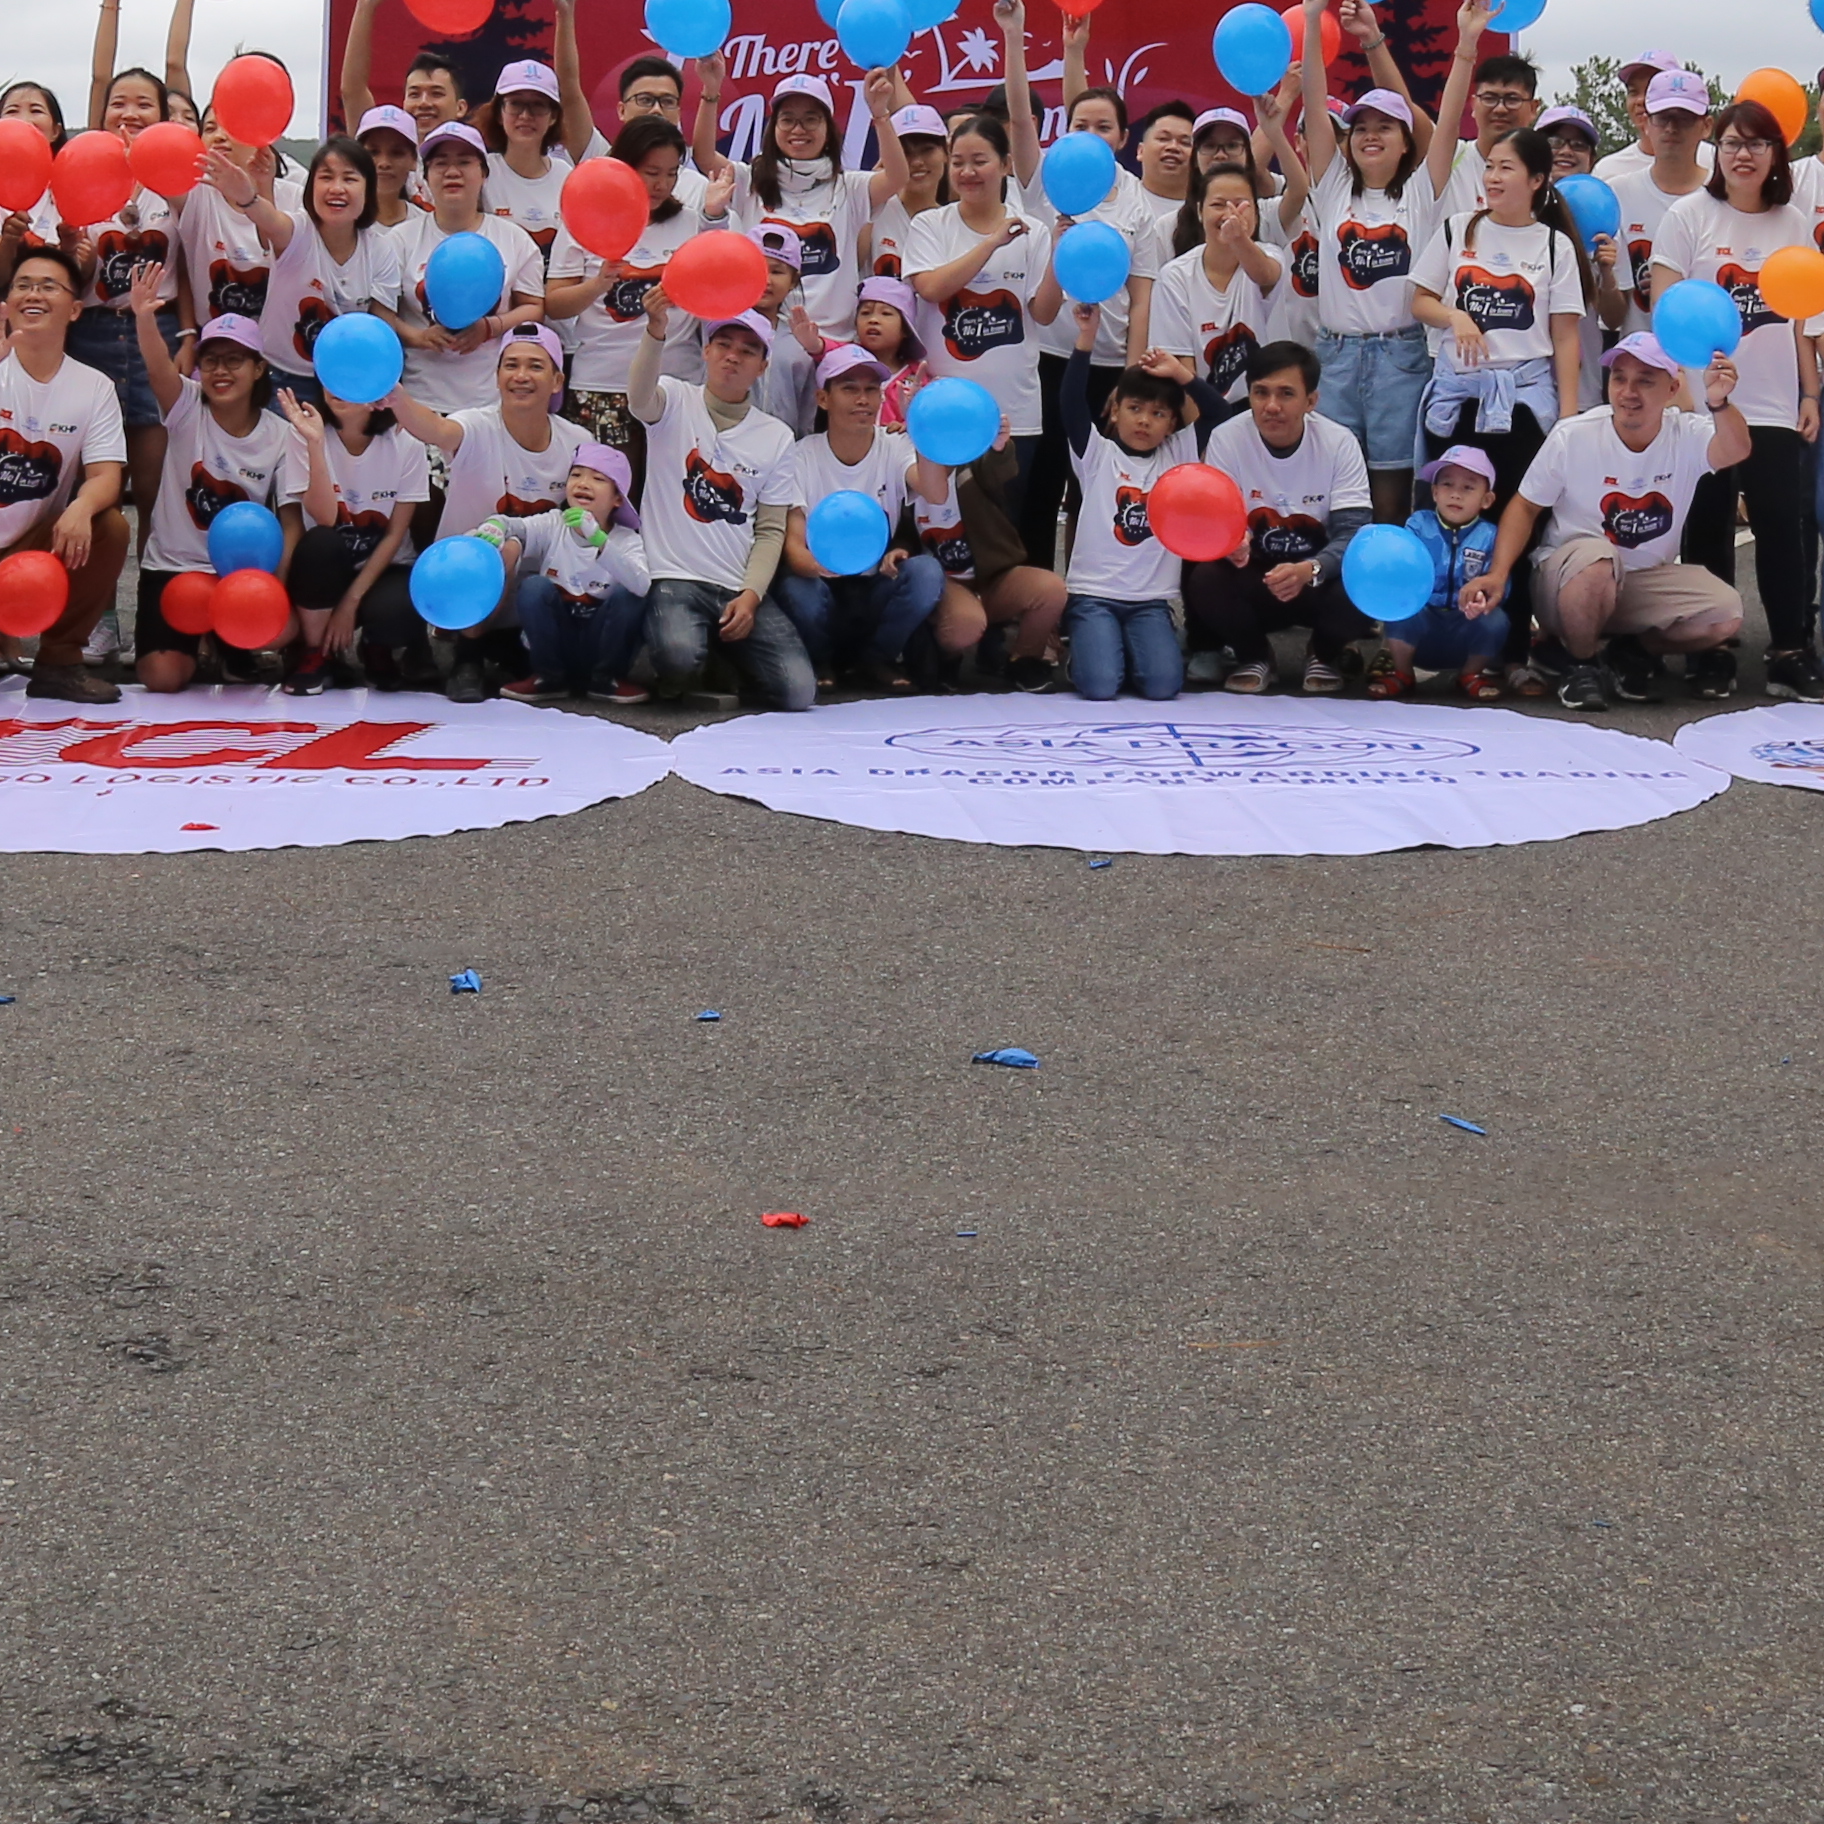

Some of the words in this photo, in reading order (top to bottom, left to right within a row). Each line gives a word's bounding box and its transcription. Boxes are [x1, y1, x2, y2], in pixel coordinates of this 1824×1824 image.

[724, 33, 839, 80] There
[945, 738, 1100, 748] ASIA
[1129, 740, 1426, 751] DRAGON
[71, 772, 323, 786] LOGISTIC
[719, 767, 840, 776] ASIA
[868, 767, 1075, 777] DRAGON
[1104, 768, 1441, 778] FORWARDING
[1465, 769, 1689, 779] TRADING
[967, 777, 1216, 786] COMPANY
